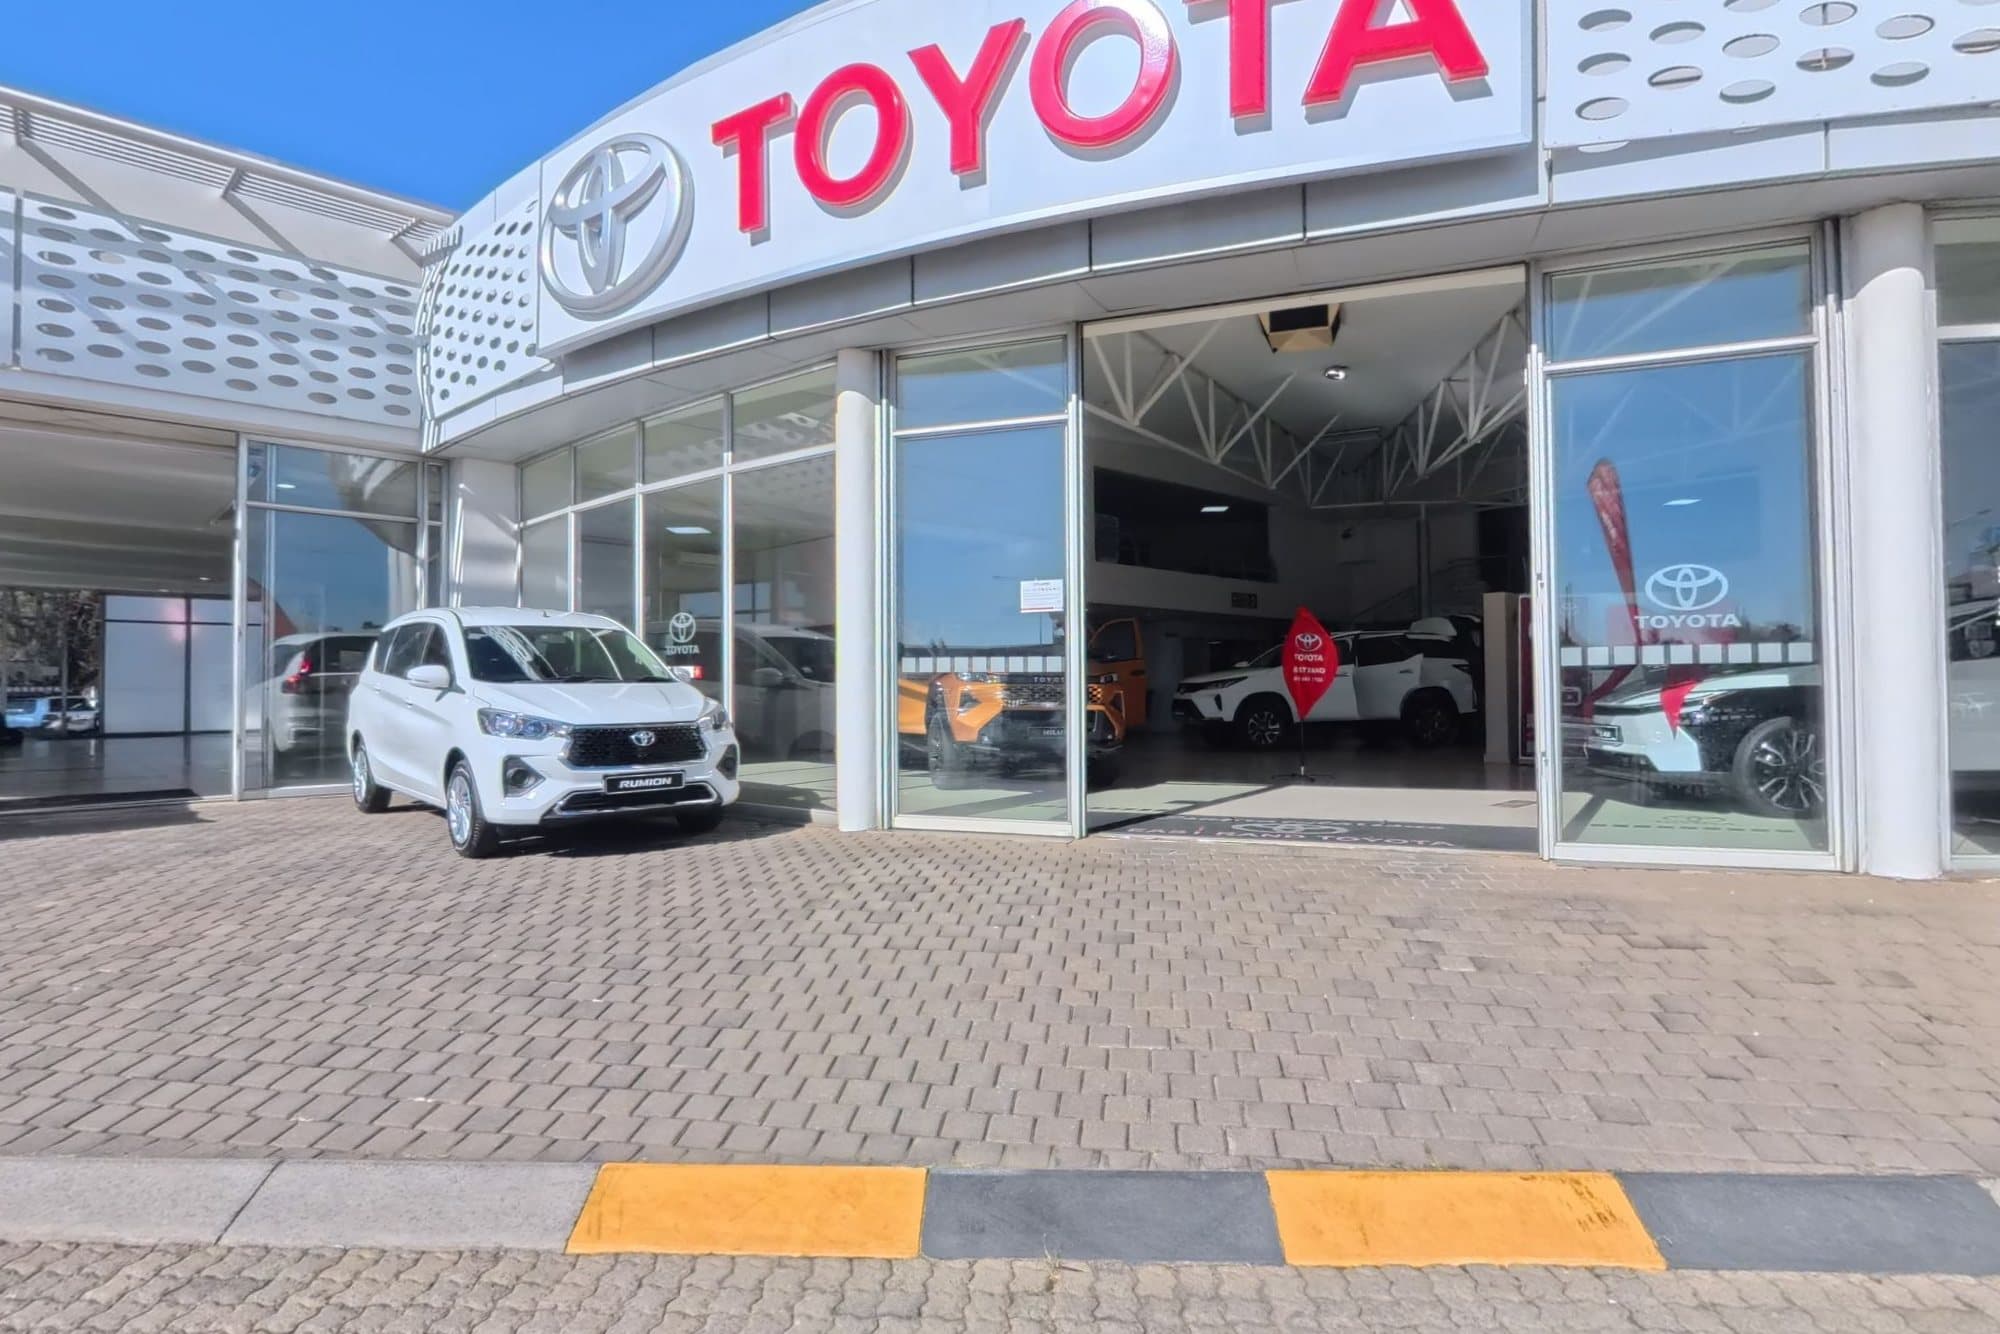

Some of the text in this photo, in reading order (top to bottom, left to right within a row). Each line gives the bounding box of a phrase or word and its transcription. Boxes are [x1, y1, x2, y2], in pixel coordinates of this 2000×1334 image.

[711, 0, 1489, 234] TOYOTA
[1634, 613, 1742, 629] TOYOTA
[666, 645, 700, 655] TOYOTA
[1294, 653, 1324, 662] TOYOTA
[619, 776, 673, 789] RUMION
[1320, 834, 1456, 848] TOYOTA
